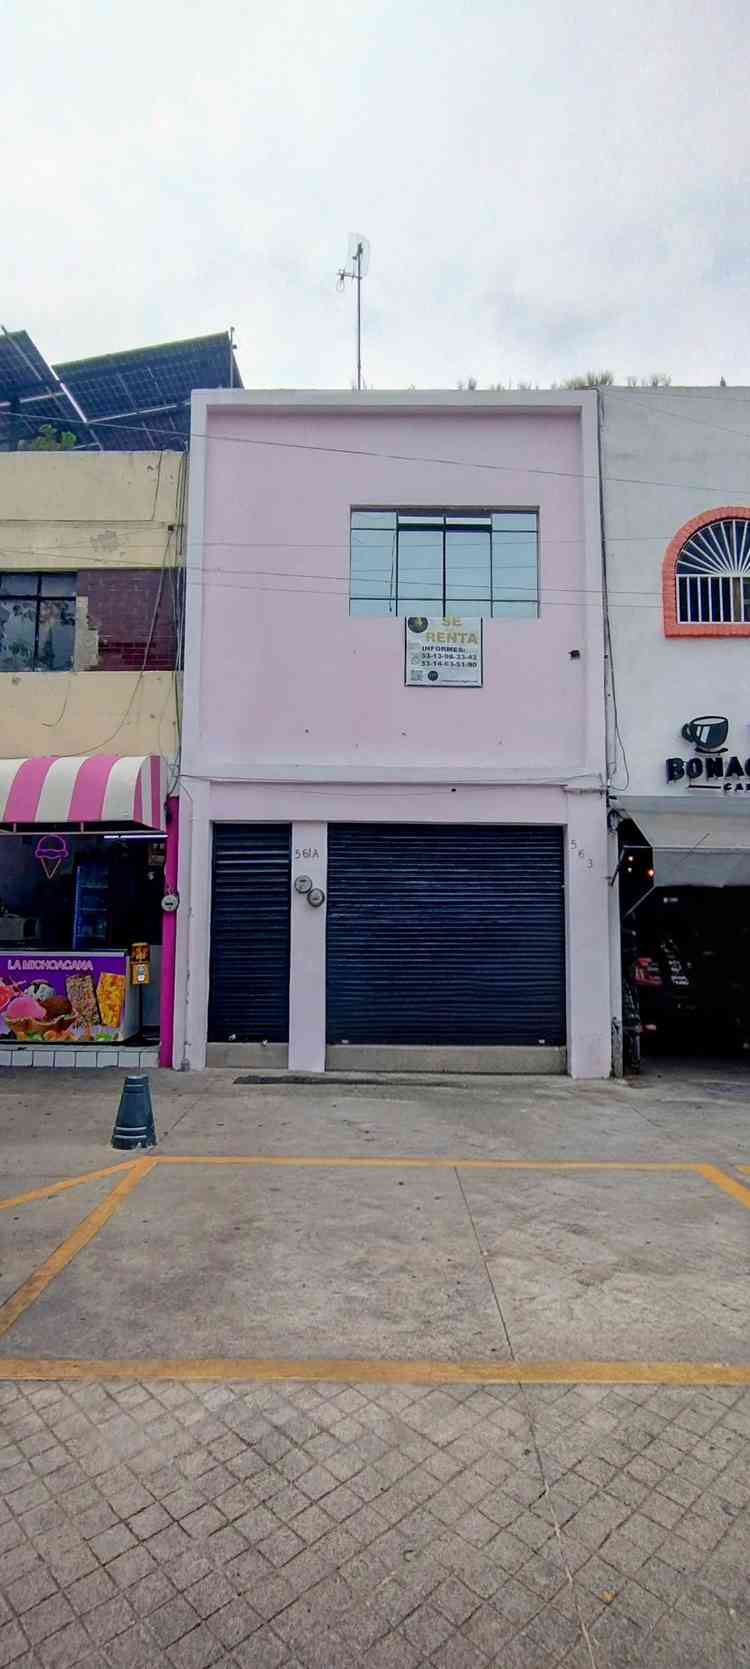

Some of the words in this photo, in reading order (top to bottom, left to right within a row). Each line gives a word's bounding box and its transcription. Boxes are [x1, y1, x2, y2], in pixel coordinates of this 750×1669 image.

[427, 632, 478, 644] RENTA
[7, 960, 21, 970] LA
[22, 960, 94, 971] MICHOACANA
